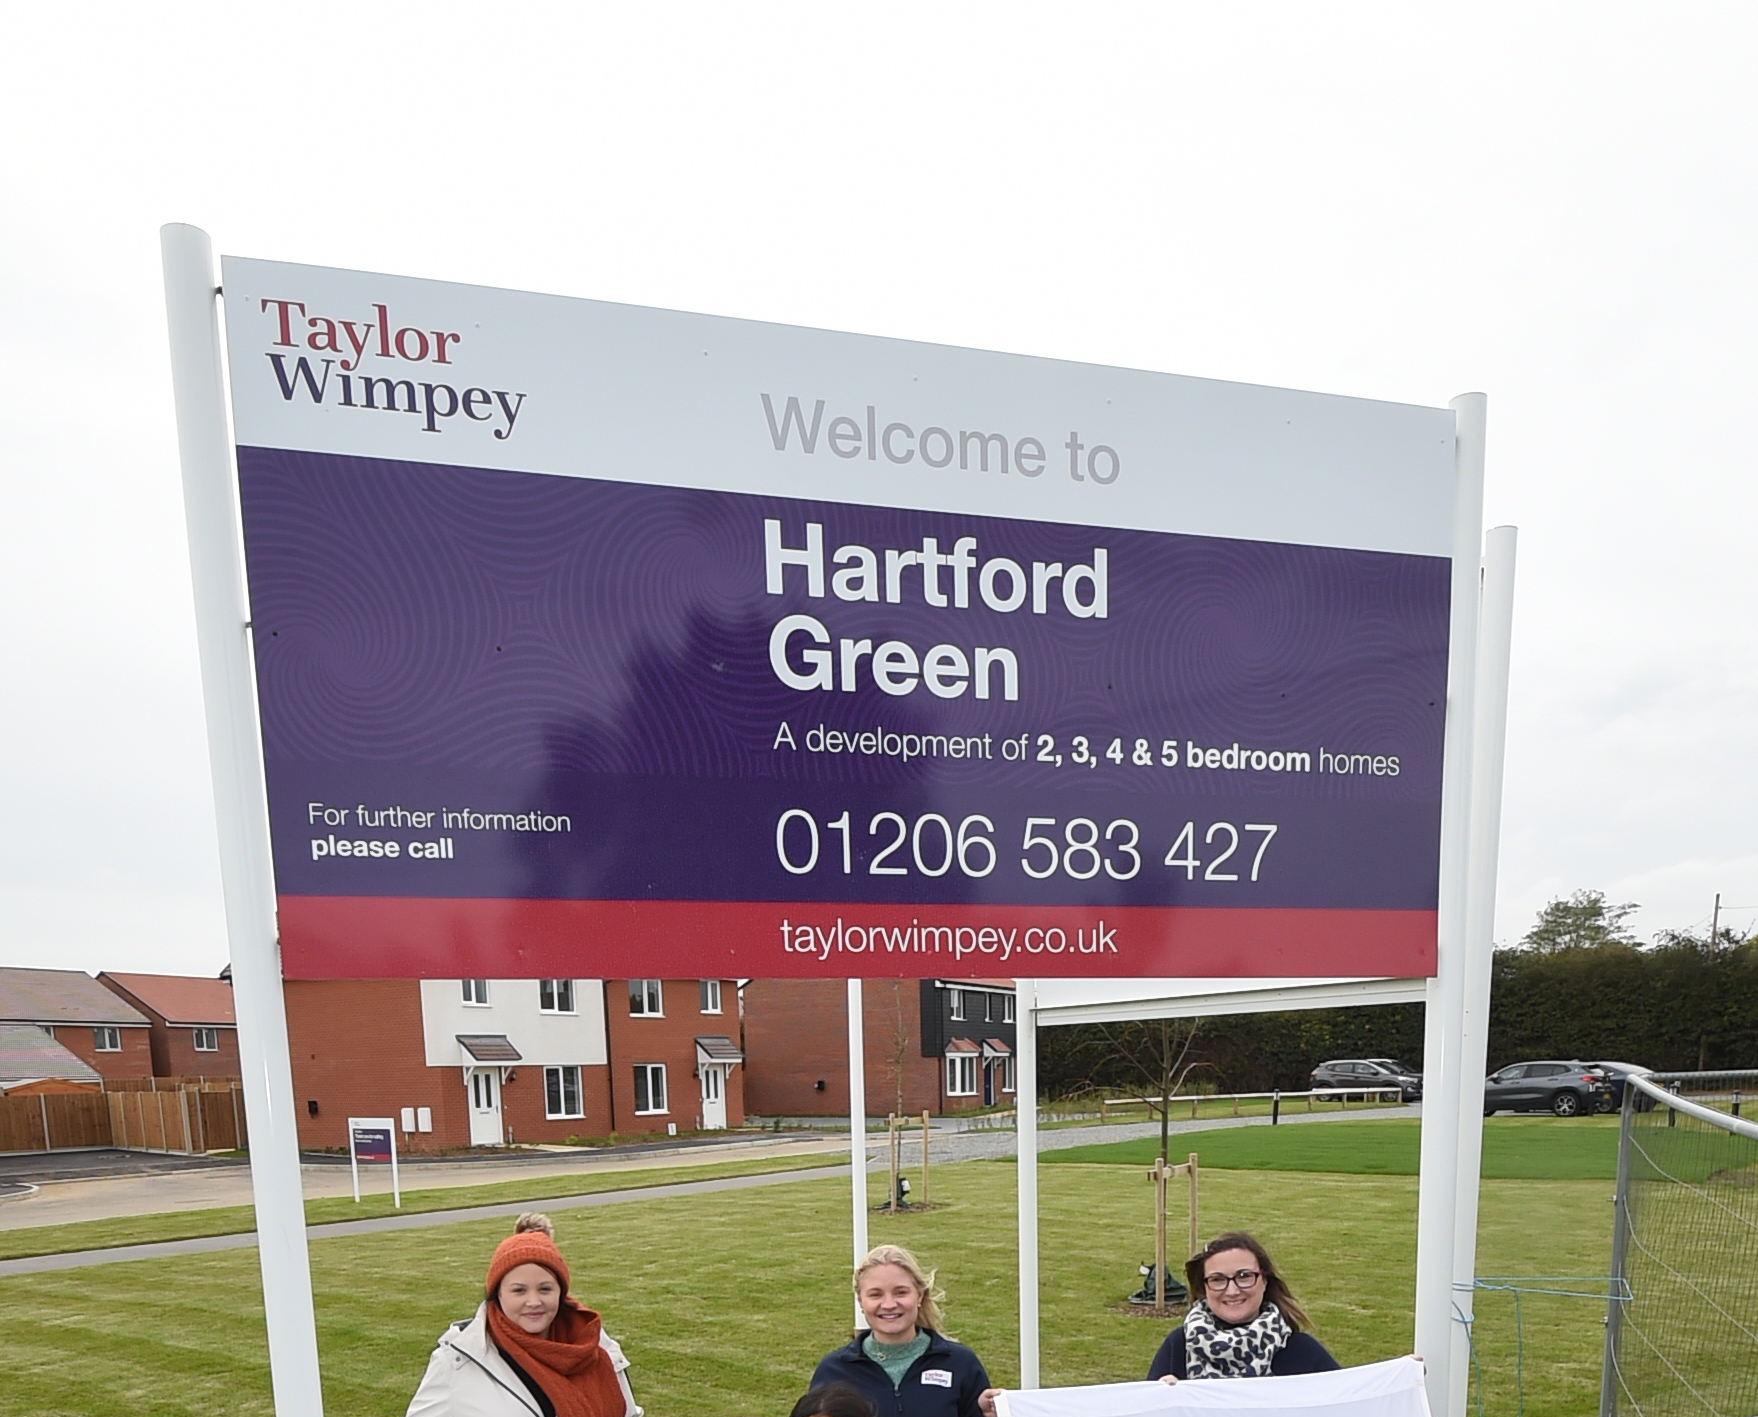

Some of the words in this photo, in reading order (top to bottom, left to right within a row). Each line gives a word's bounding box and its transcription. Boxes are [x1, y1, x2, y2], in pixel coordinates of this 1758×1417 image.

[261, 298, 460, 371] Taylor
[265, 352, 527, 440] Wimpey
[761, 393, 1046, 478] Welcome
[1065, 430, 1120, 484] to
[764, 518, 1108, 618] Hartford
[768, 614, 1019, 701] Green
[773, 721, 797, 750] A
[806, 724, 993, 762] development
[1001, 733, 1029, 761] of
[1036, 734, 1063, 768] 2,
[1071, 736, 1097, 769] 3,
[1105, 738, 1124, 765] 4
[1131, 738, 1153, 766] &
[1160, 740, 1178, 767] 5
[1186, 741, 1311, 772] bedroom
[1319, 747, 1400, 776] homes
[308, 803, 349, 826] For
[356, 804, 435, 829] further
[442, 807, 571, 832] information
[311, 834, 401, 861] please
[407, 837, 454, 860] call
[776, 808, 997, 878] 01206
[1020, 817, 1141, 881] 583
[1164, 822, 1278, 882] 427
[780, 918, 1118, 960] taylorwimpey.co.uk
